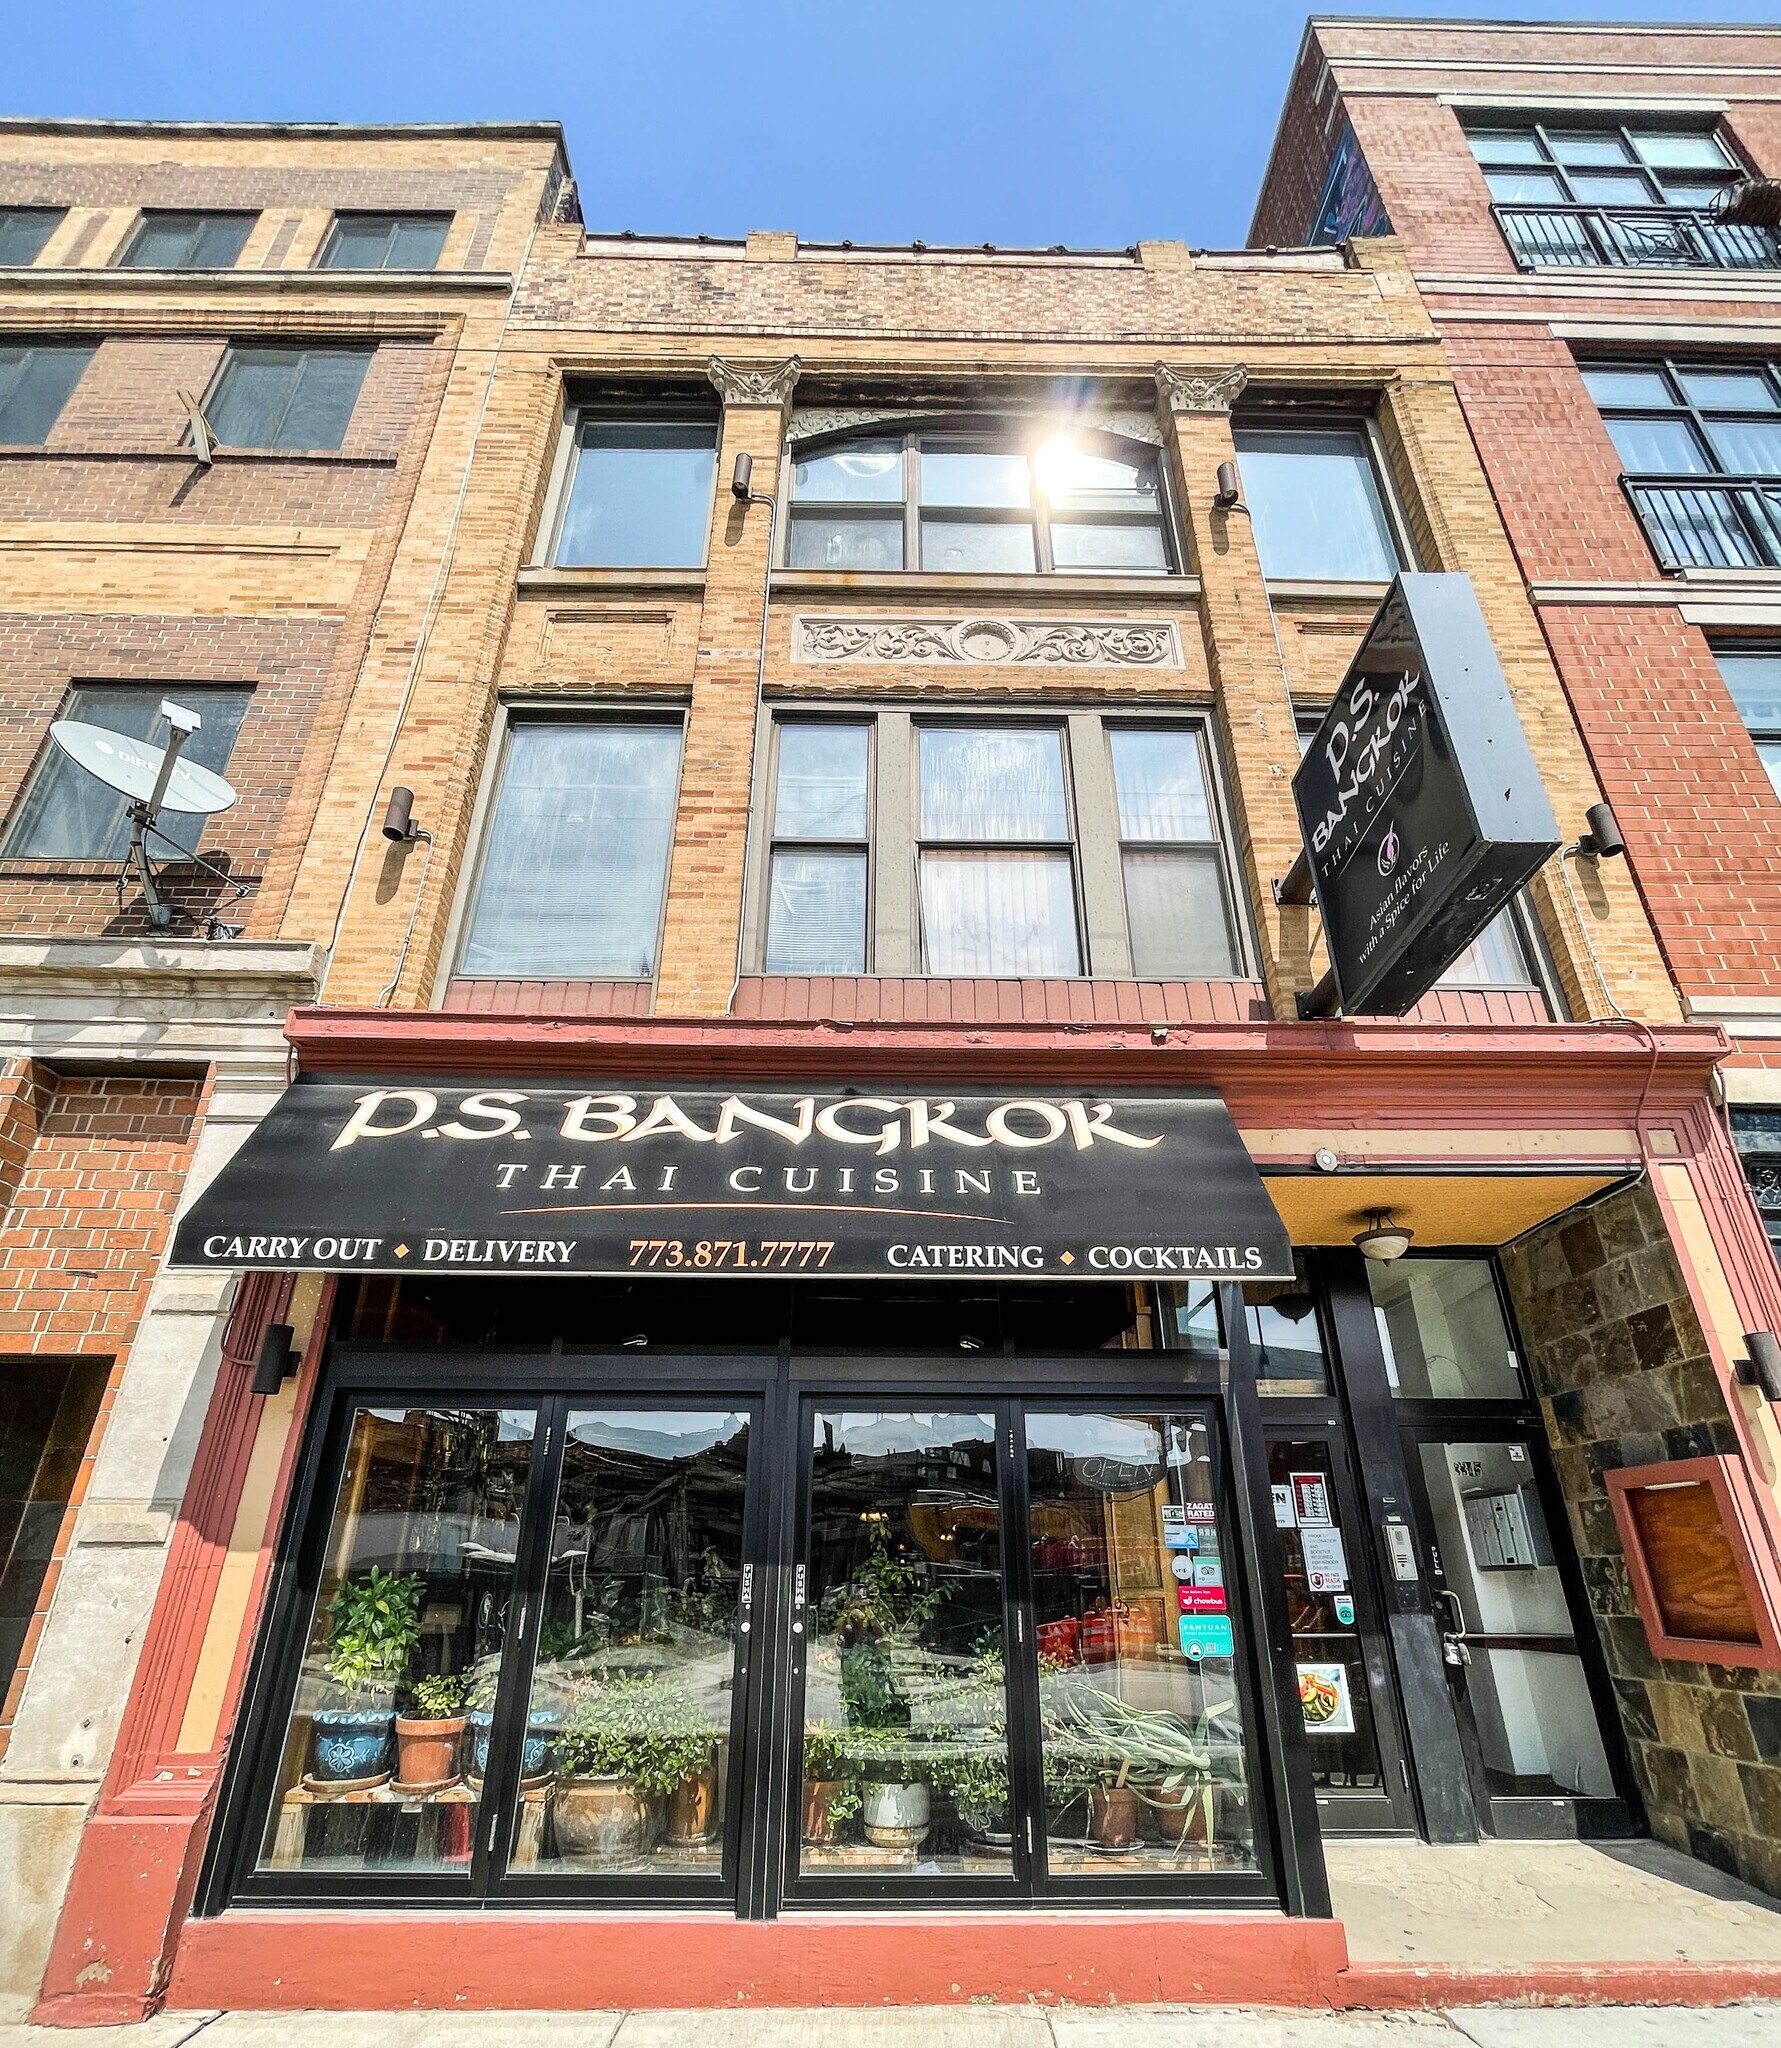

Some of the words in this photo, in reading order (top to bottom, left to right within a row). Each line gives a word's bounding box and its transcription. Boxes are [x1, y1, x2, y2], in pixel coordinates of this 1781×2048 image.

[1326, 677, 1380, 784] P.S.
[118, 750, 191, 781] DIRETV
[1312, 670, 1420, 852] BANGKOK
[1321, 821, 1358, 877] THAI
[1365, 699, 1427, 813] CUISINE
[1359, 936, 1378, 964] with
[1385, 893, 1410, 929] Spice
[1411, 871, 1426, 894] for
[1428, 842, 1449, 872] Life
[1370, 893, 1394, 930] Asian
[1395, 846, 1428, 893] flavors
[329, 1090, 532, 1151] P.S.
[559, 1094, 1165, 1156] BANGKOK
[496, 1164, 679, 1191] THAI
[729, 1166, 1042, 1195] CUISINE
[203, 1236, 309, 1260] CARRY
[313, 1238, 382, 1261] OUT
[423, 1239, 577, 1263] DELIVERY
[629, 1240, 835, 1267] 773.871.7777
[887, 1244, 1044, 1268] CATERING
[1088, 1246, 1263, 1270] COCKTAILS
[1082, 1456, 1157, 1478] OPEN
[1186, 1502, 1214, 1510] ZAGAT
[743, 1565, 751, 1594] PUSH
[1194, 1597, 1223, 1605] chowbus
